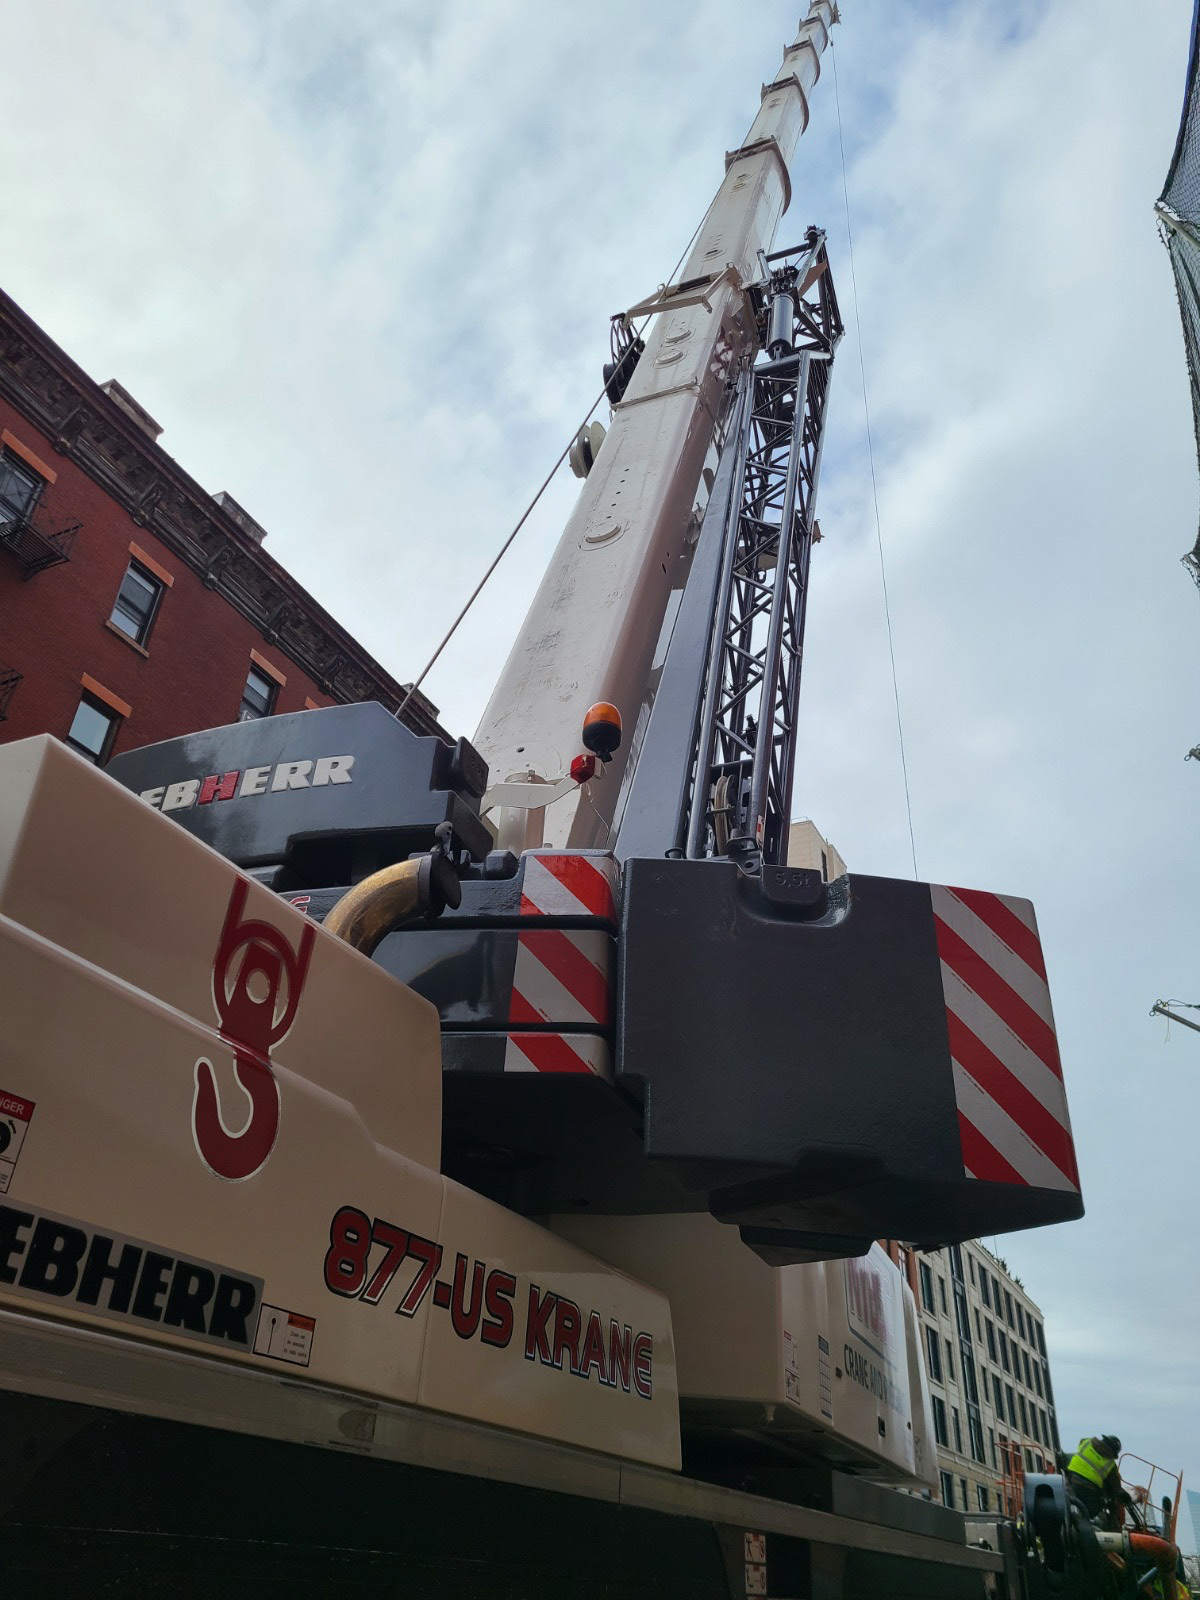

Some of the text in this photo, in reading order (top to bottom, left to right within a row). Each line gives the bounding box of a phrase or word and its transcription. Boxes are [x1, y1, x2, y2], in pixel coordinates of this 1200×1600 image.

[775, 871, 811, 888] 5,5t
[324, 1205, 653, 1400] 877-US KRANE
[843, 1343, 869, 1390] CRANE
